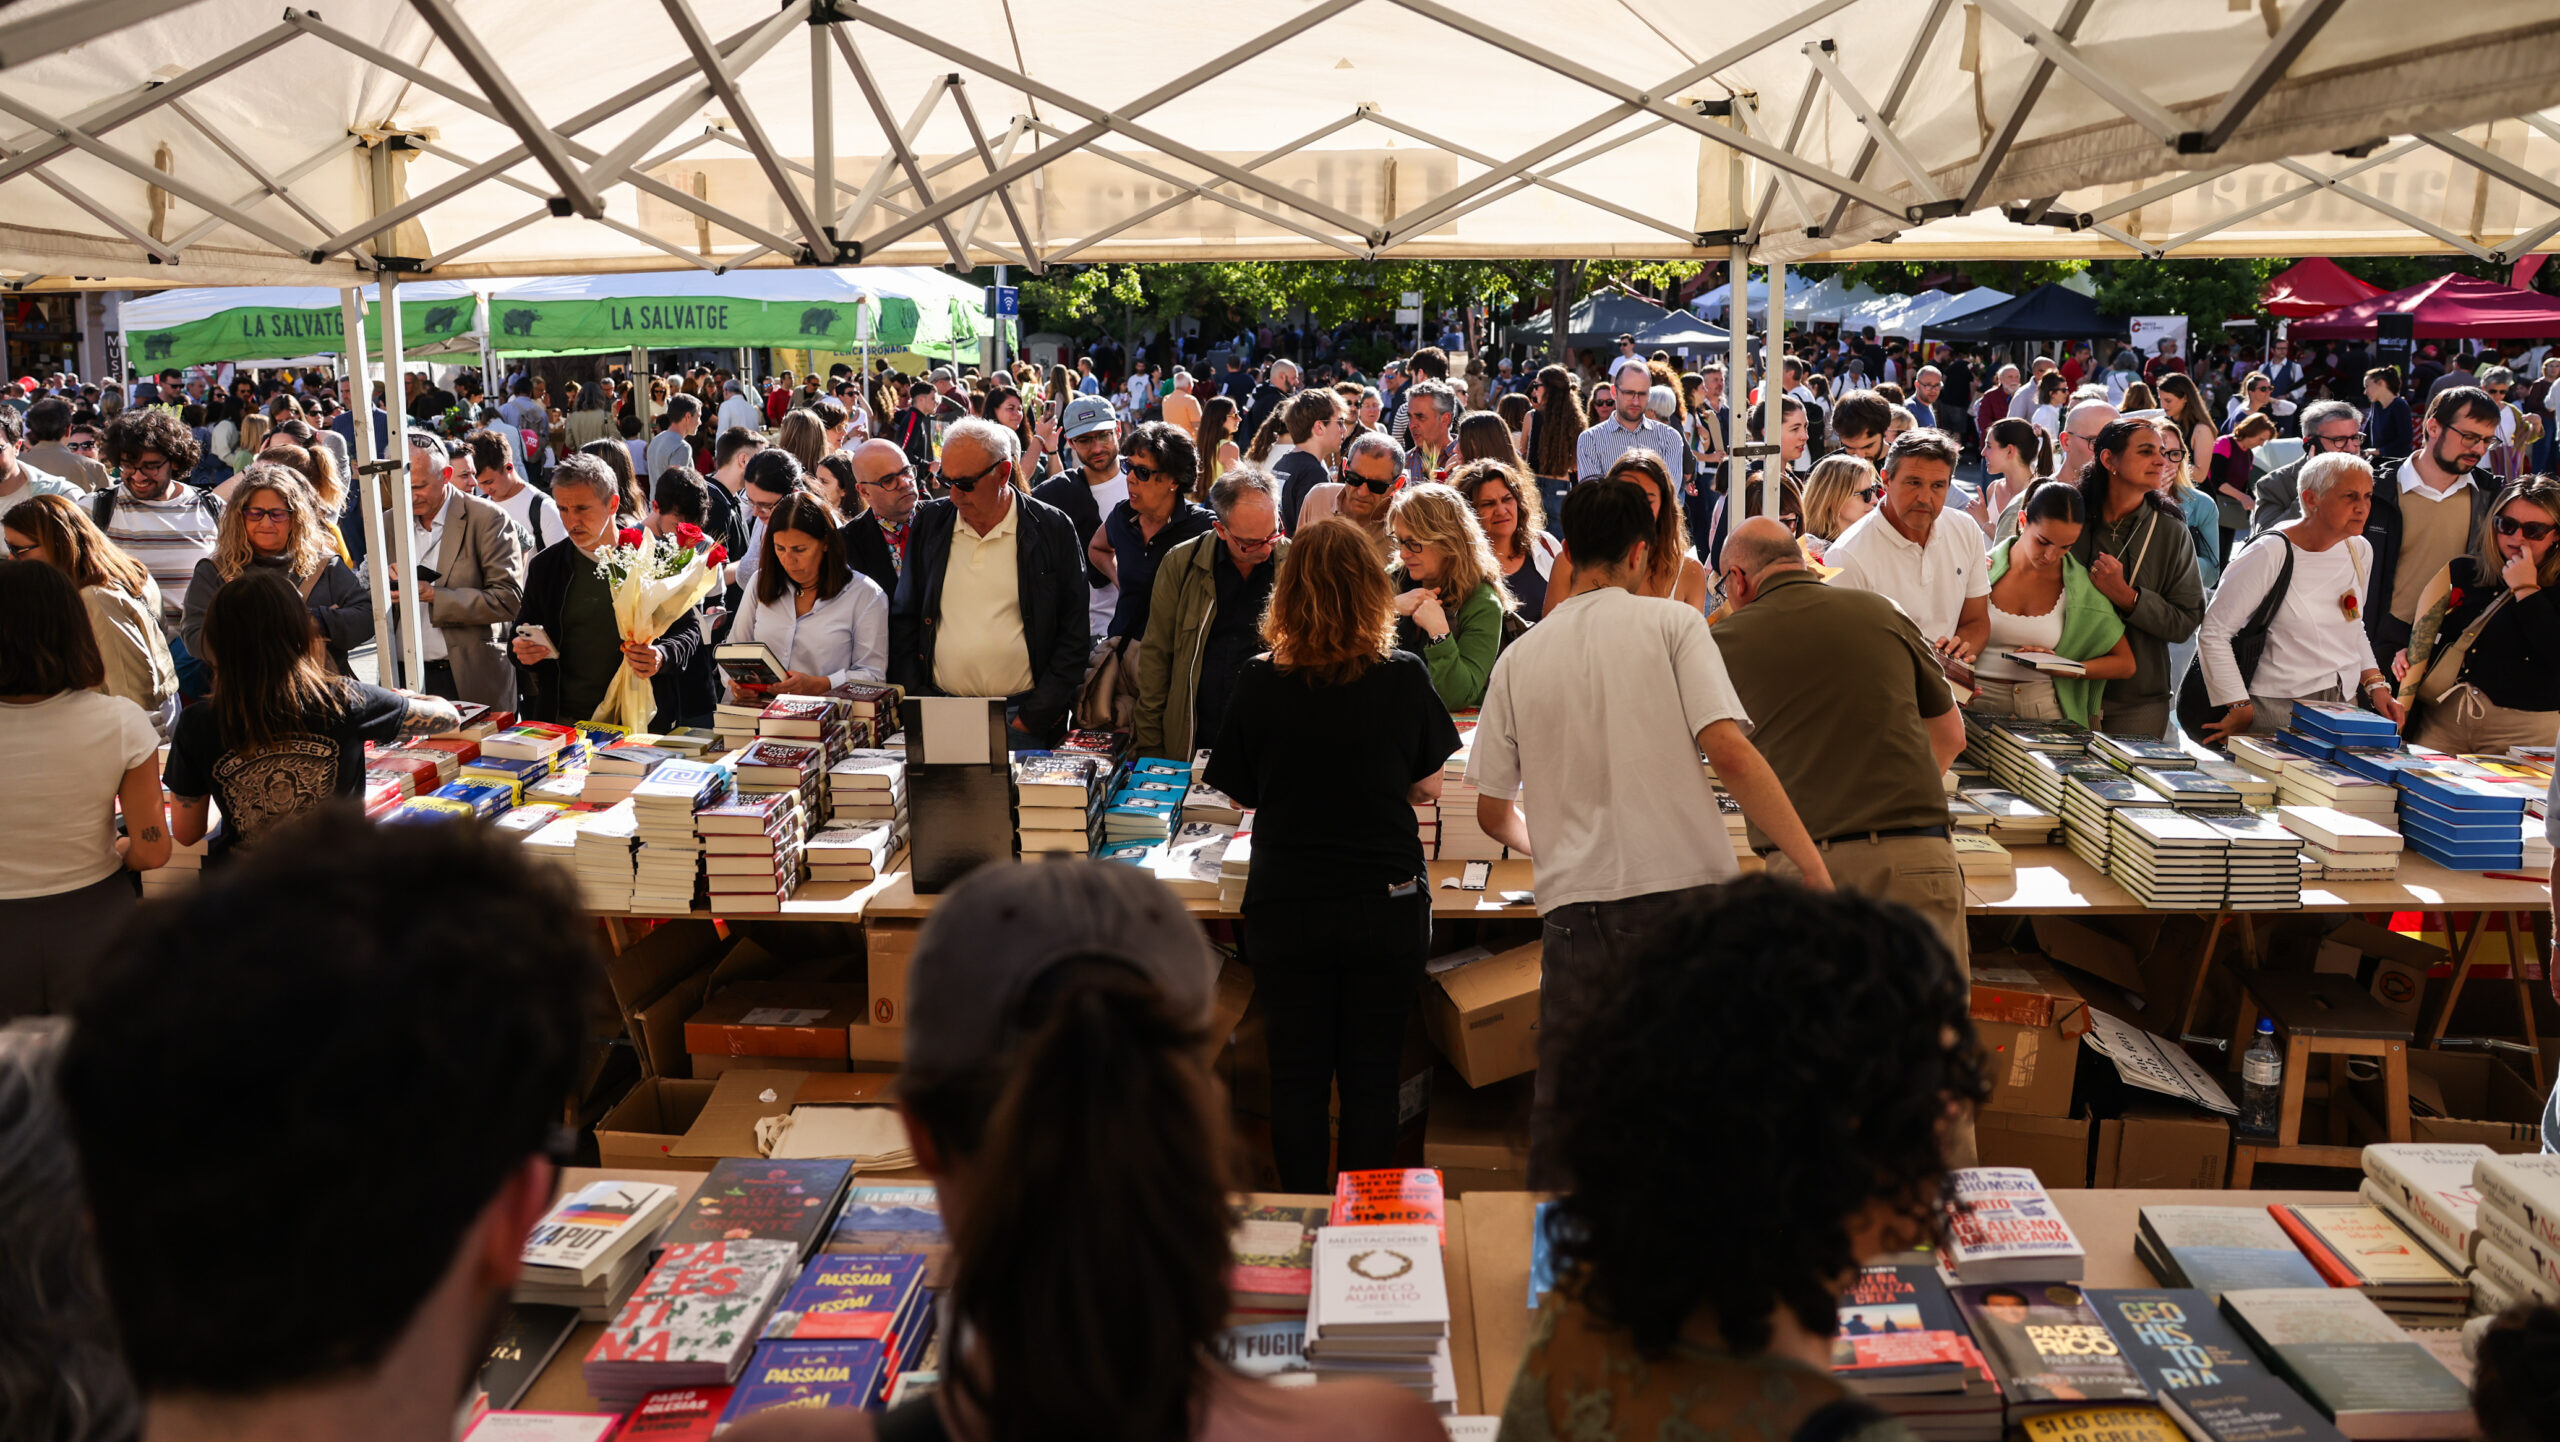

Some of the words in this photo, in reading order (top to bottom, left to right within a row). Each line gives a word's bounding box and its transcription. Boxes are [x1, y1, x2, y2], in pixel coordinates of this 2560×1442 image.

[243, 314, 266, 337] LA
[612, 306, 634, 331] LA
[640, 305, 729, 330] SALVATGE
[1954, 1180, 2036, 1193] CHOMSKY
[720, 1197, 801, 1207] PASEO
[730, 1208, 776, 1218] POR
[2414, 1195, 2450, 1239] Nexus
[690, 1219, 797, 1232] ORIENTE
[1952, 1219, 2062, 1236] IDEALISMO
[1329, 1235, 1428, 1245] MEDITACIONES
[1960, 1230, 2069, 1247] AMERICANO
[2017, 1242, 2074, 1250] ROBINSON
[652, 1241, 727, 1268] PA
[631, 1267, 744, 1298] LES
[816, 1273, 892, 1286] PASSADA
[1349, 1283, 1415, 1292] MARCO
[1344, 1292, 1421, 1303] AURELIO
[1855, 1294, 1897, 1305] CREA
[619, 1300, 674, 1329] TI
[2118, 1302, 2187, 1324] GEO
[2024, 1325, 2109, 1339] PADRE
[2131, 1323, 2194, 1346] HIS
[584, 1331, 671, 1362] NA
[2031, 1337, 2119, 1356] RICO
[802, 1356, 828, 1364] LA
[2162, 1345, 2213, 1368] TO
[763, 1367, 850, 1384] PASSADA
[2160, 1367, 2221, 1389] RIA
[649, 1391, 697, 1403] PABLO
[642, 1400, 708, 1414] IGLESIAS
[2036, 1415, 2058, 1434] SI
[2062, 1416, 2089, 1431] LO
[2094, 1428, 2164, 1442] CREAS
